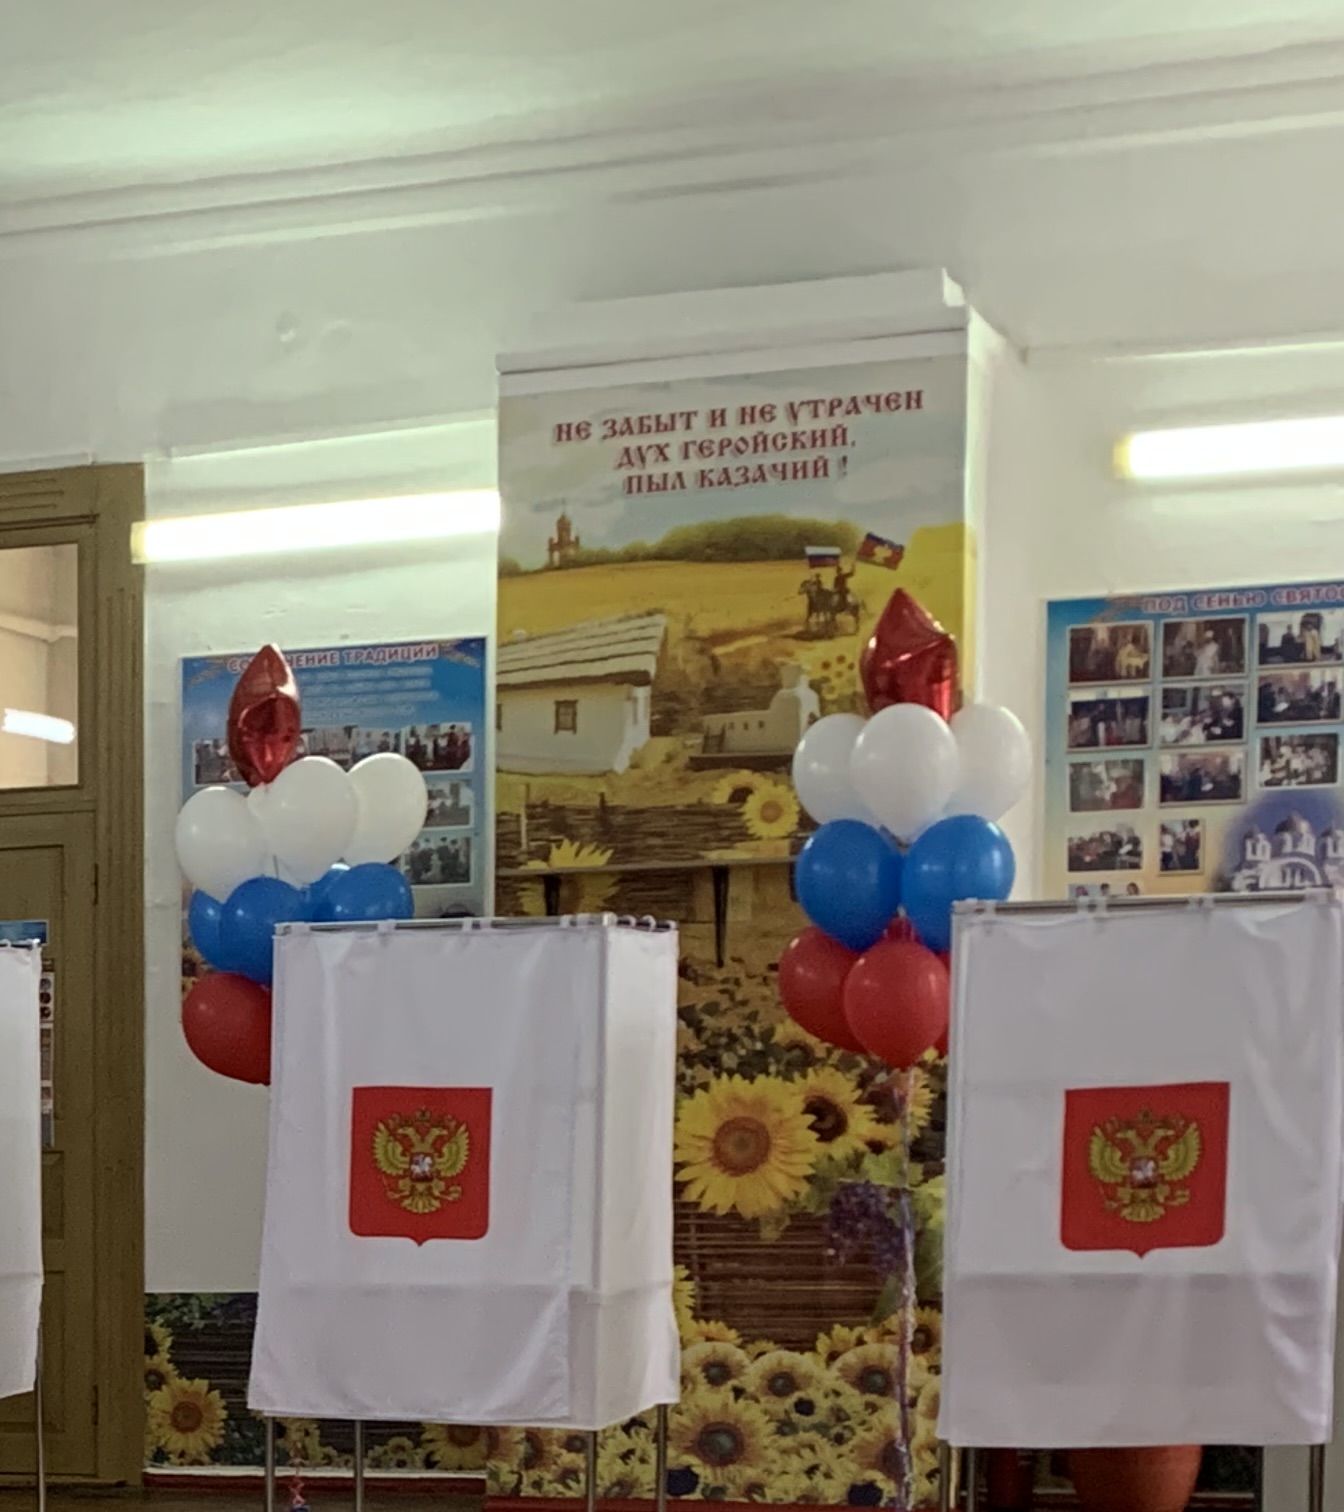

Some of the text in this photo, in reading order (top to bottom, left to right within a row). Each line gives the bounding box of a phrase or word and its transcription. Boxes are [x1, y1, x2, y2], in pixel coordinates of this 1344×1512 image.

[554, 420, 592, 444] НЕ
[601, 410, 699, 440] ЗАБЫТ
[708, 407, 728, 429] И
[739, 403, 778, 426] НЕ
[624, 470, 687, 496] ПЫЛ
[698, 454, 830, 489] КАЗАЧИЙ
[1271, 585, 1344, 605] СВЯТО
